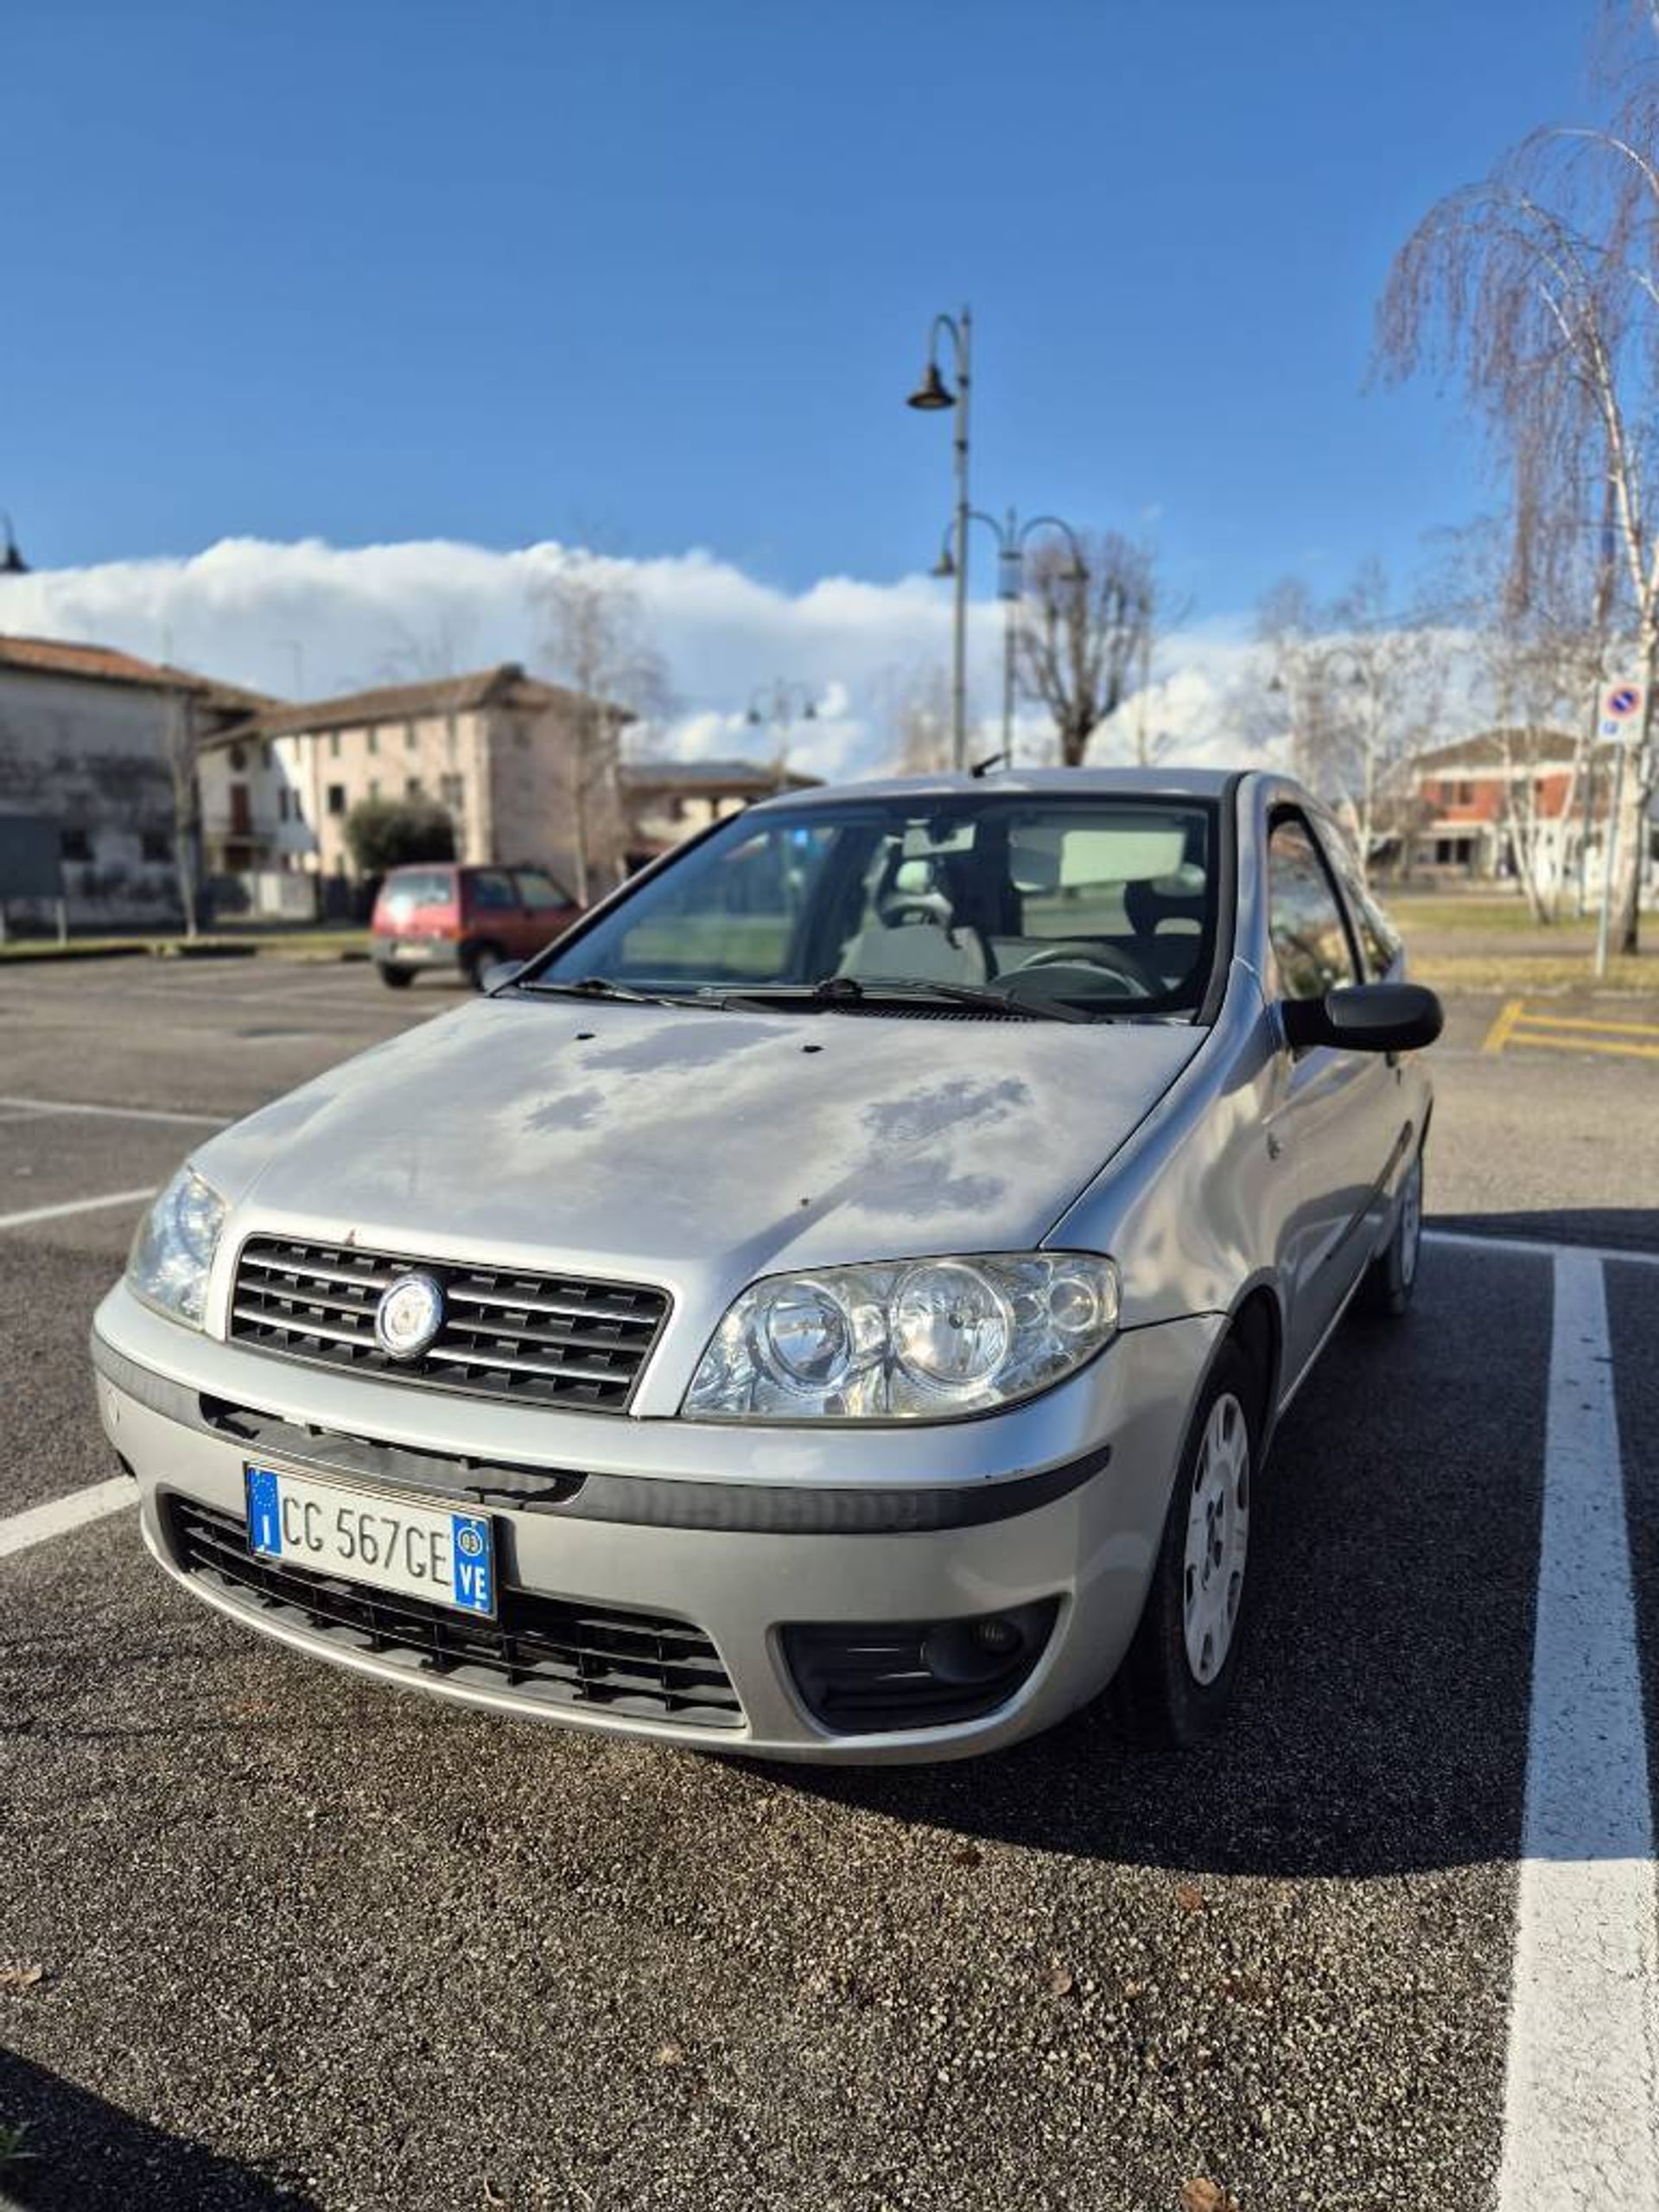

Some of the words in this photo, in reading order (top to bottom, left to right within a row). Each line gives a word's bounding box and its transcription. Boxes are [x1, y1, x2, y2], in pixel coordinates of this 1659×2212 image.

[262, 1515, 271, 1546] I
[283, 1497, 324, 1553] CG
[337, 1508, 451, 1586] 567GE
[460, 1563, 487, 1600] VE
